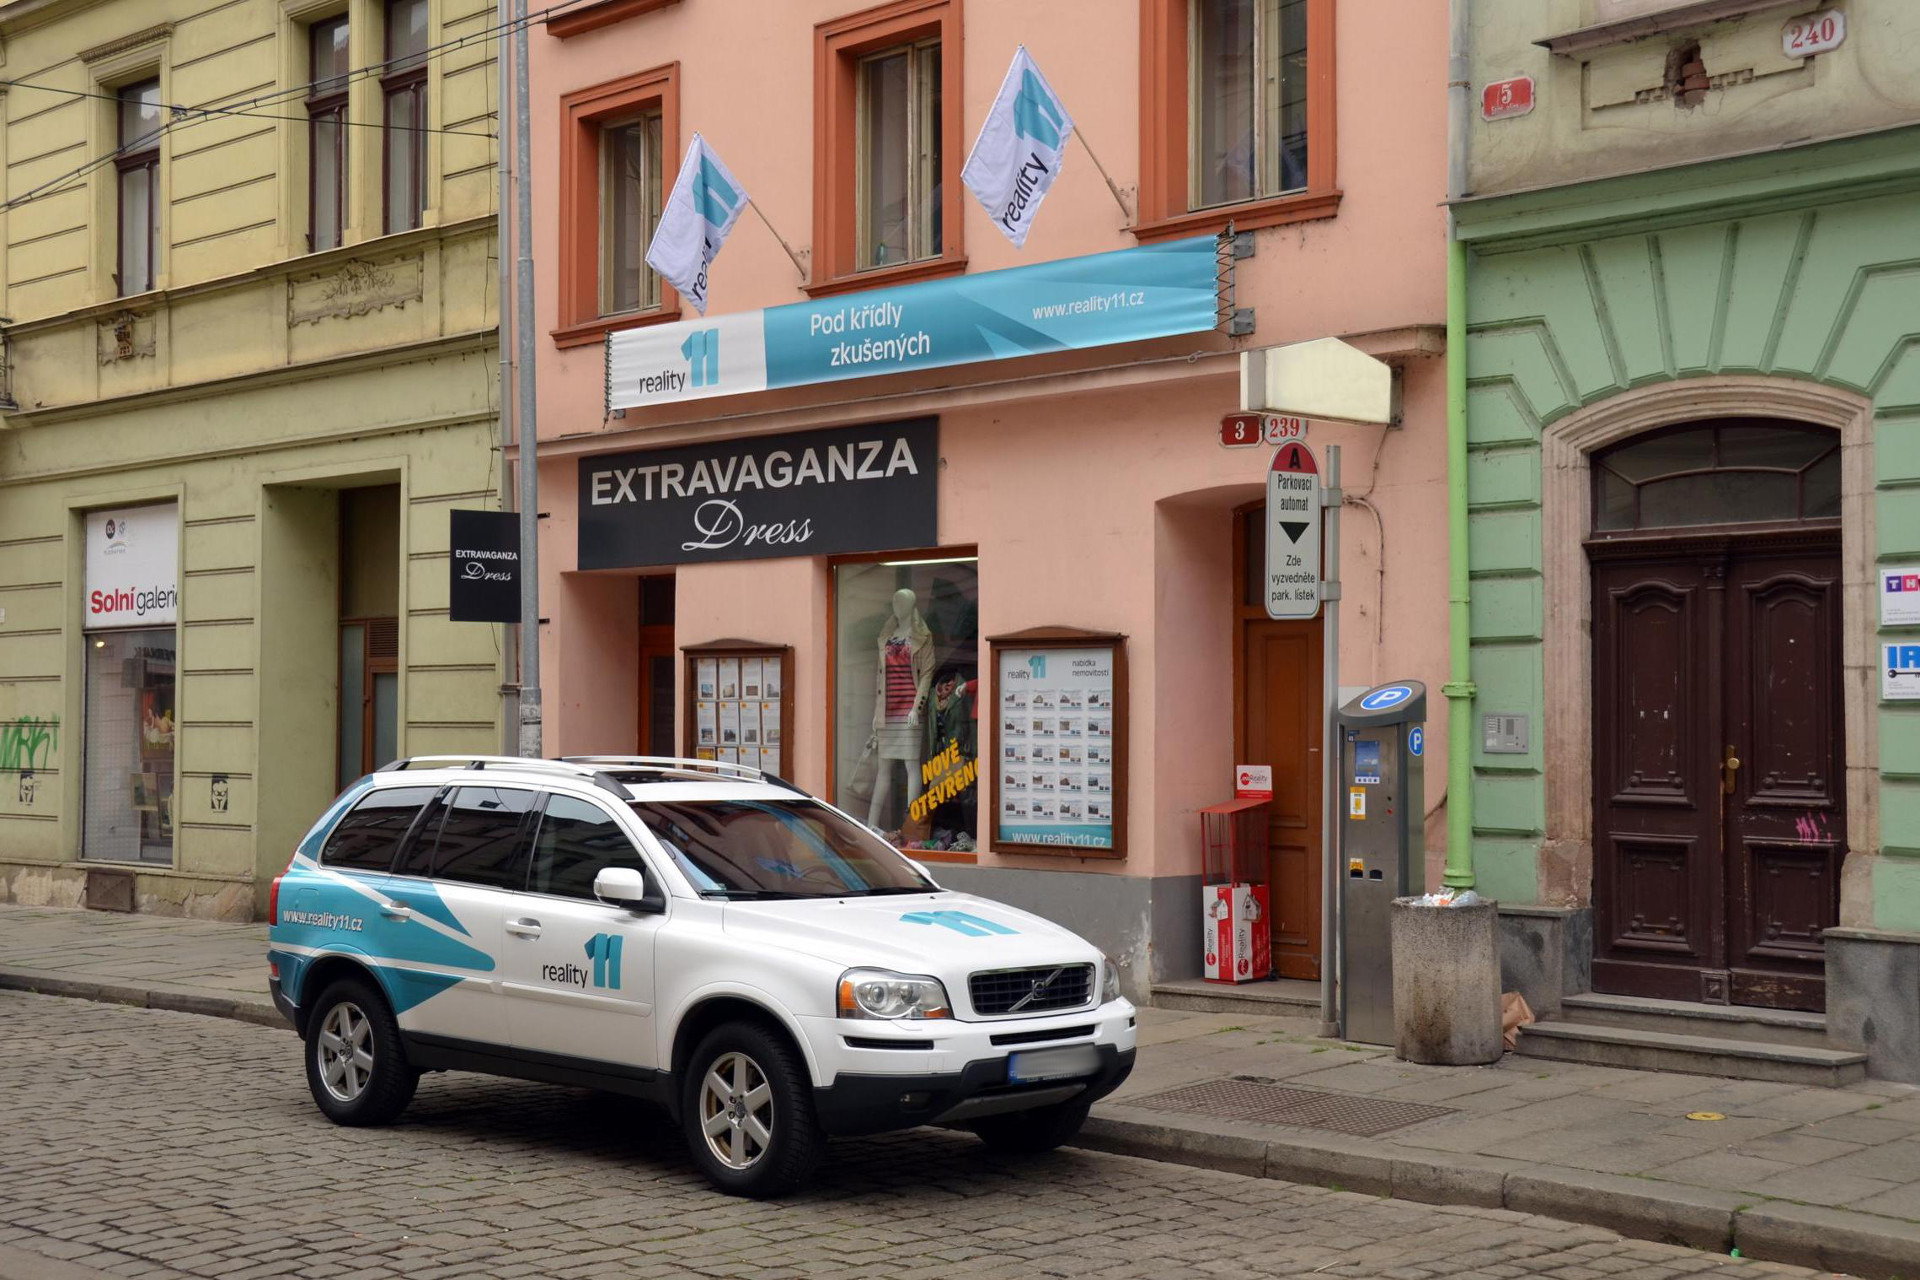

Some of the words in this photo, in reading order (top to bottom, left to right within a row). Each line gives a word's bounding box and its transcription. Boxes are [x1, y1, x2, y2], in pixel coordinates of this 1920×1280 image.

[1790, 17, 1835, 49] 240
[1501, 82, 1513, 104] 5
[1001, 152, 1049, 233] reality
[1031, 291, 1145, 320] www.reality11.cz
[810, 308, 845, 336] Pod
[850, 301, 903, 328] křídly
[830, 330, 930, 366] zkušených
[639, 369, 686, 394] reality
[681, 328, 719, 388] 11
[1234, 421, 1246, 440] 3
[1269, 417, 1300, 438] 239
[1288, 447, 1301, 469] A
[591, 437, 919, 506] EXTRAVAGANZA
[1277, 473, 1313, 491] Parkovací
[1280, 495, 1309, 511] automat
[681, 499, 813, 551] Dress
[455, 549, 518, 560] EXTRAVAGANZA
[1286, 554, 1302, 567] Zde
[461, 561, 512, 581] Dress
[1271, 571, 1316, 586] vyzvedněte
[91, 586, 136, 614] Solní
[1271, 589, 1292, 602] park.
[1294, 587, 1315, 601] lístek
[1007, 669, 1031, 680] reality
[1028, 655, 1046, 679] 11
[1370, 690, 1402, 706] P
[1413, 733, 1422, 750] P
[922, 737, 960, 785] NOVĚ
[283, 910, 363, 932] www.reality11.cz
[542, 963, 588, 989] reality
[584, 932, 624, 990] 11
